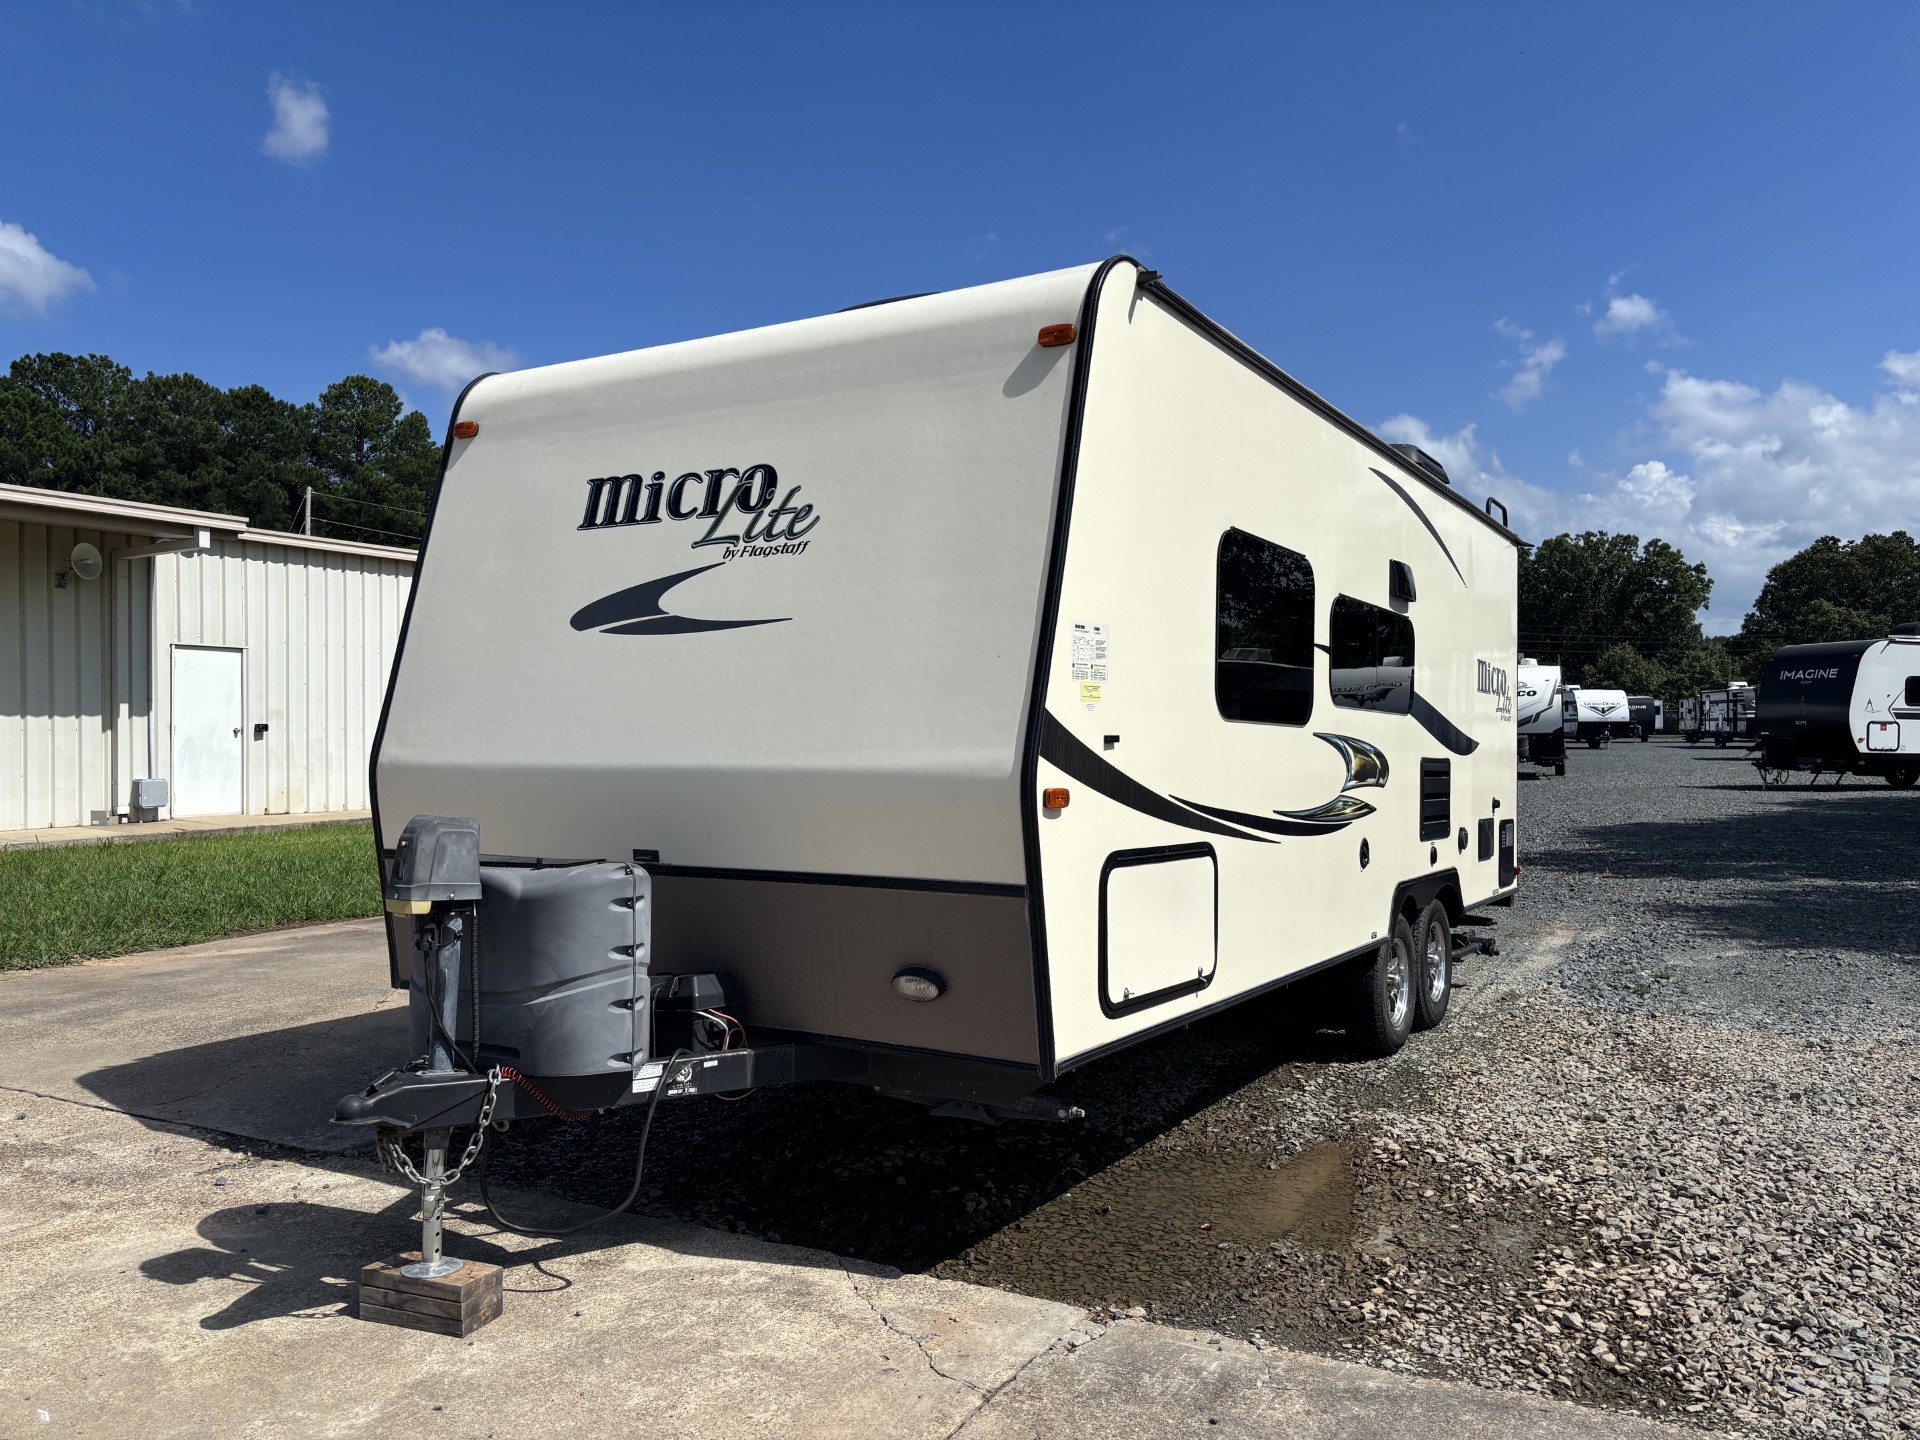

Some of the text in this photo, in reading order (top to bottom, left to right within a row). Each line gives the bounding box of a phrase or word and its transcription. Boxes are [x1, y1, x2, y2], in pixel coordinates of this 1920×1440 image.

[577, 463, 778, 530] micro
[691, 480, 820, 549] Lite
[723, 540, 811, 561] by Flagstaff
[1477, 658, 1507, 696] micro
[1779, 668, 1839, 680] IMAGINE
